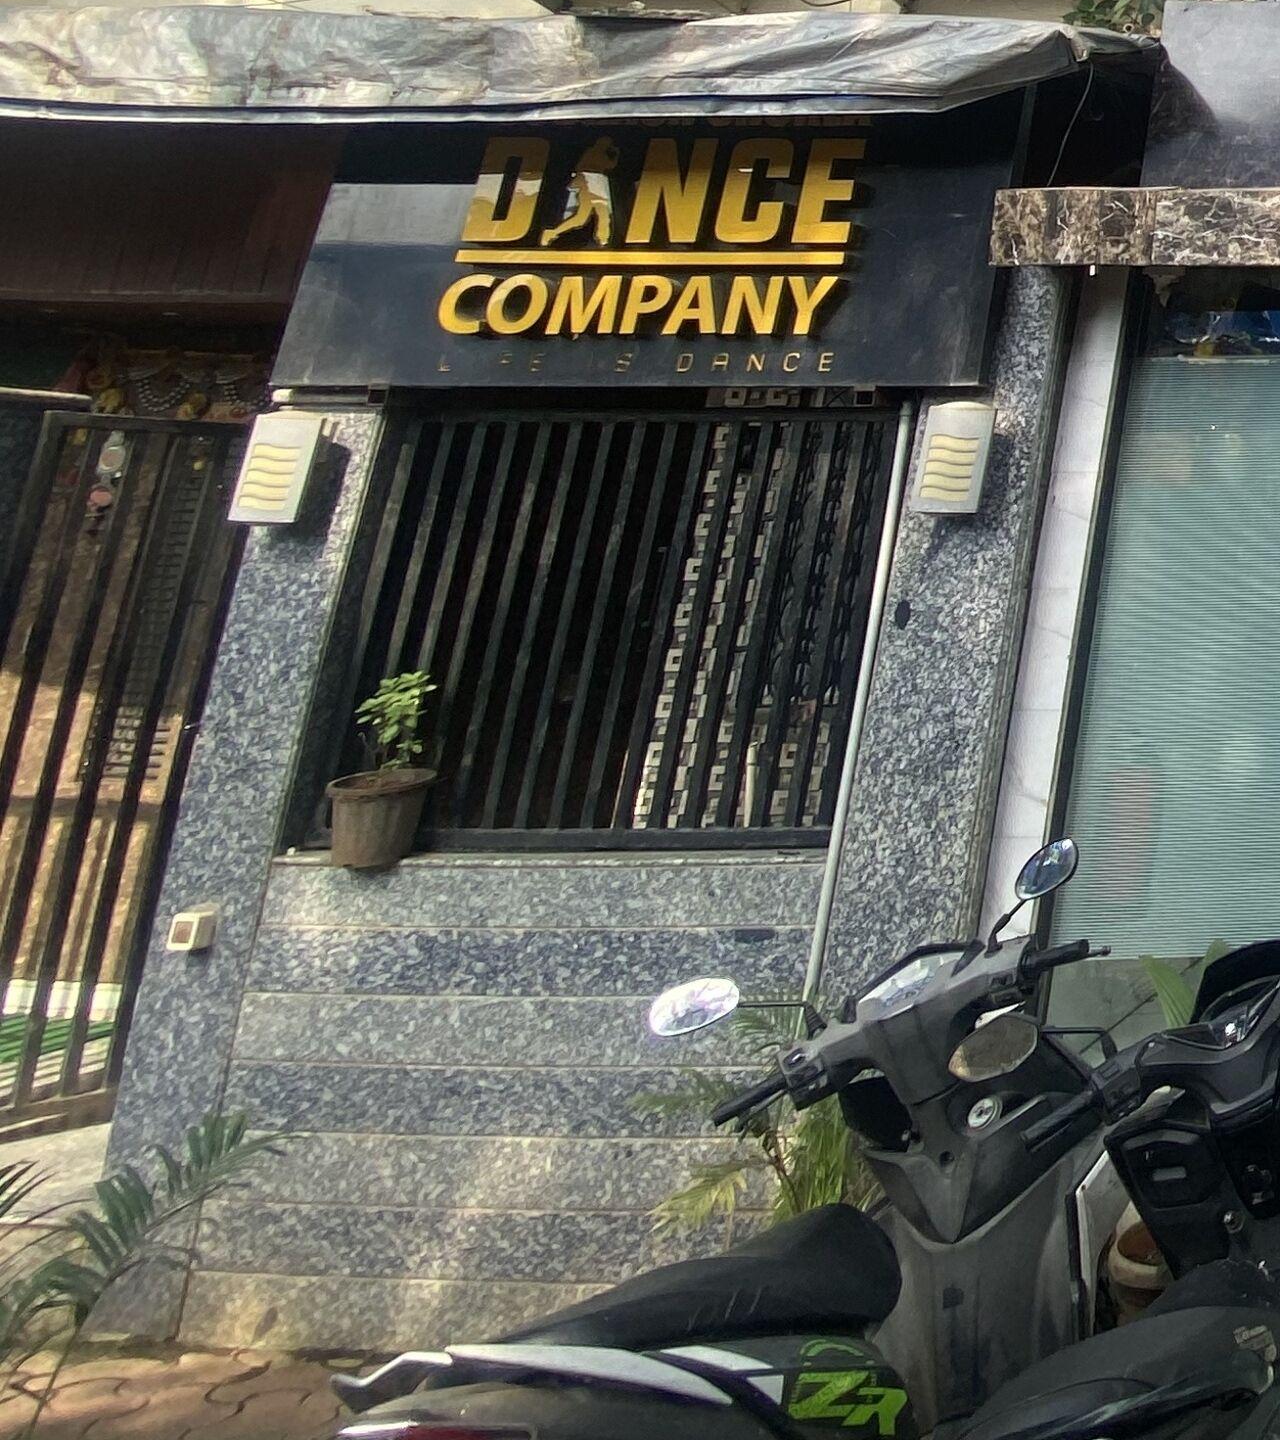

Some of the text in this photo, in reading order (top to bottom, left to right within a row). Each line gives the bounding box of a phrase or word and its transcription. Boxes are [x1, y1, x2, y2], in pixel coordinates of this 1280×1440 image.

[437, 273, 839, 336] COMPANY
[676, 352, 835, 373] DANCE
[787, 1369, 908, 1436] ZR
